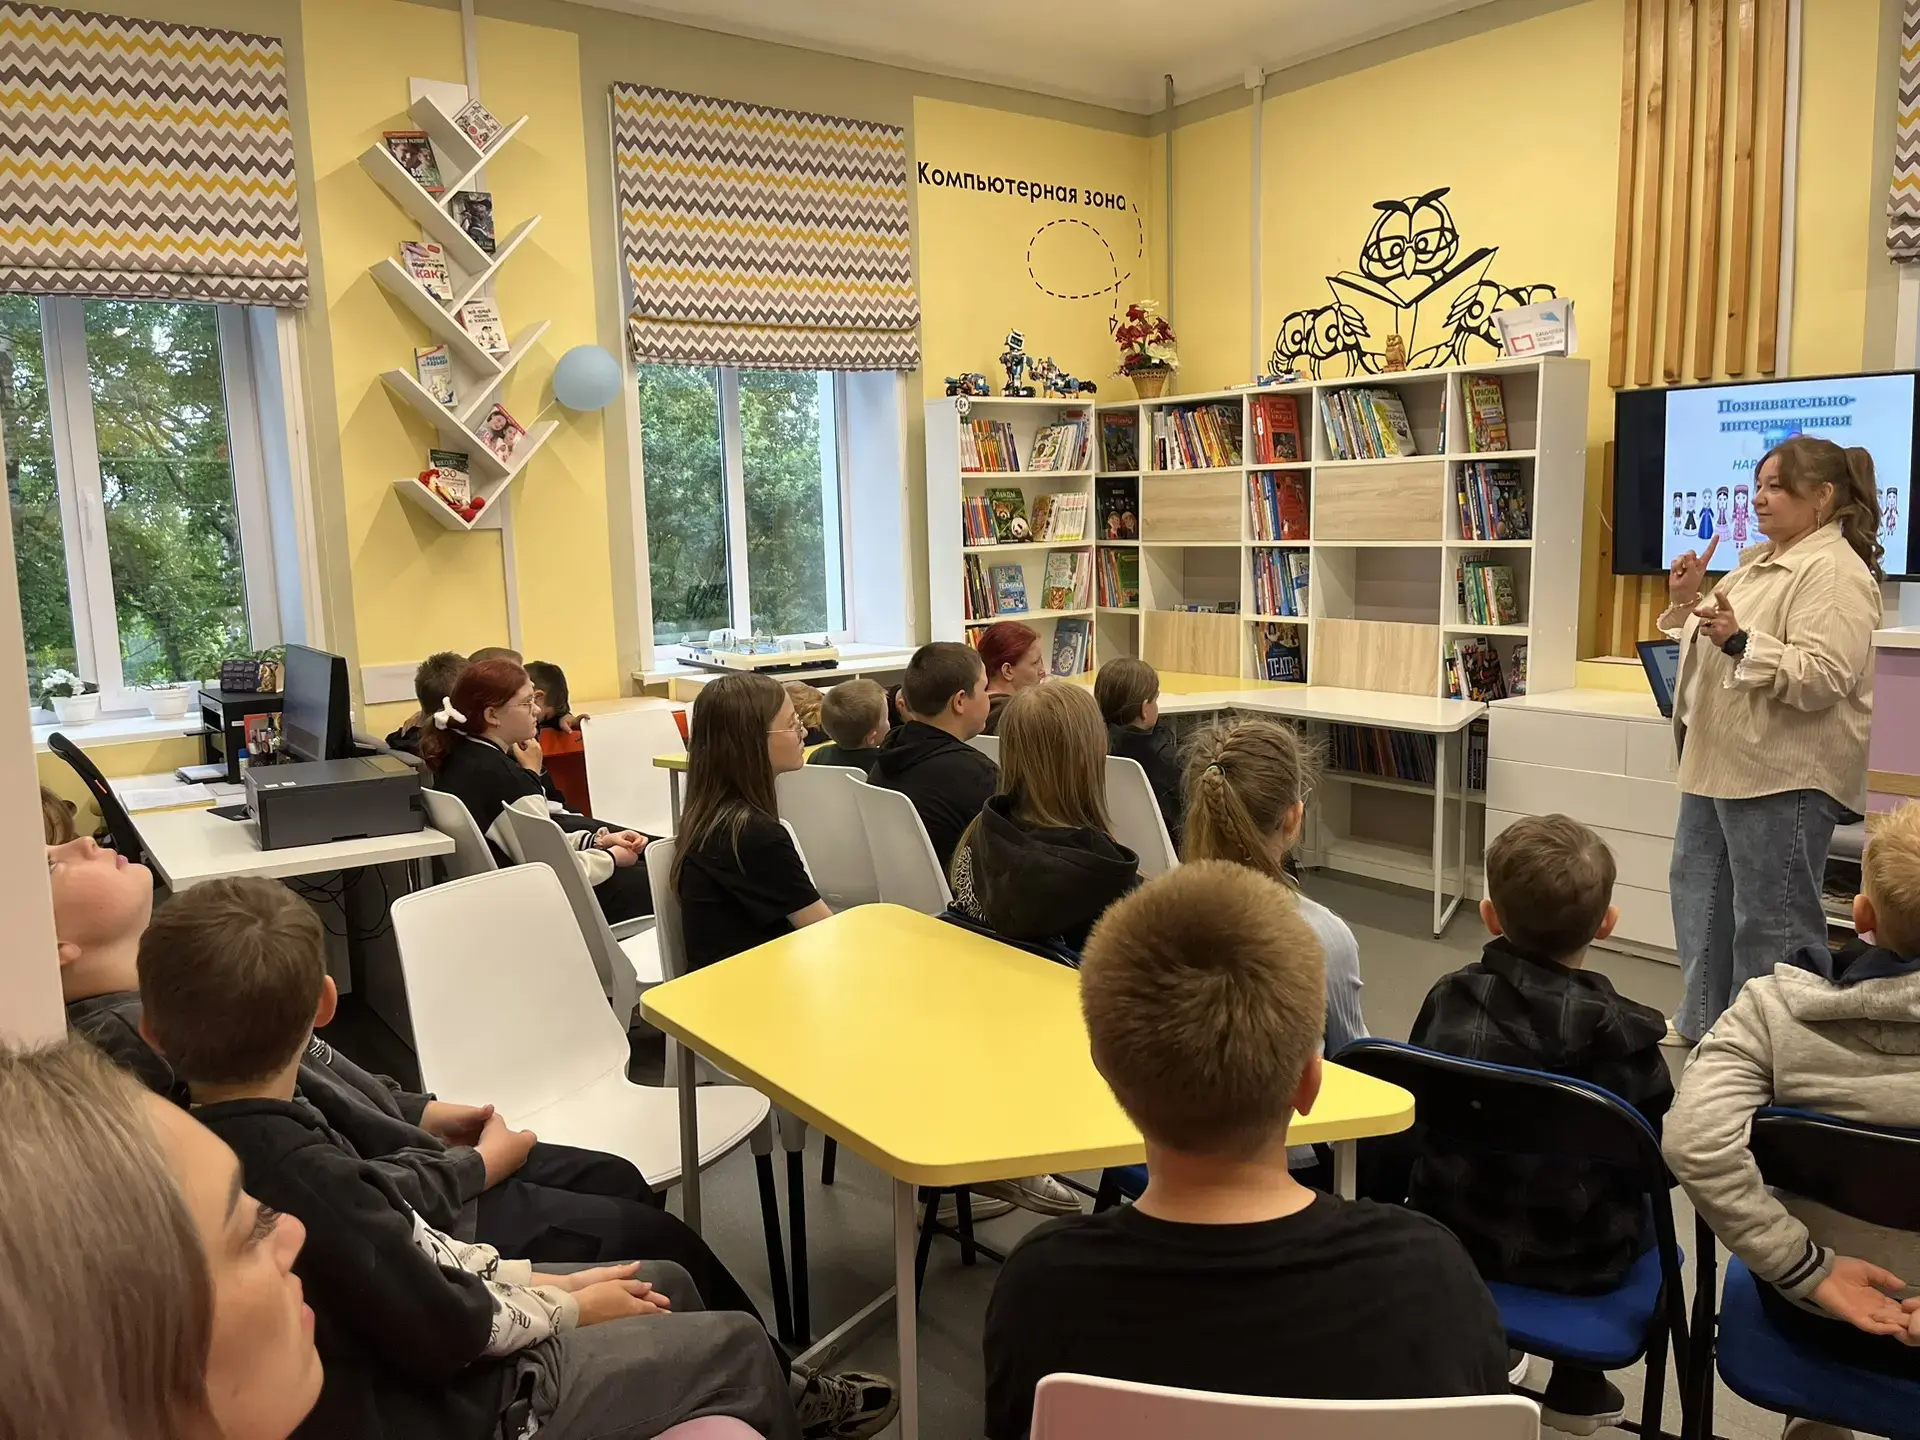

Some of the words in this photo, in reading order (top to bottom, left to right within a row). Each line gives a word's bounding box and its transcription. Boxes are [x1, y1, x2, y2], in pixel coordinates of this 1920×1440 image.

[917, 161, 1078, 203] Компьютерная
[1084, 189, 1126, 211] зона
[1718, 394, 1857, 415] Познавательно-
[1718, 414, 1852, 435] интерактивная
